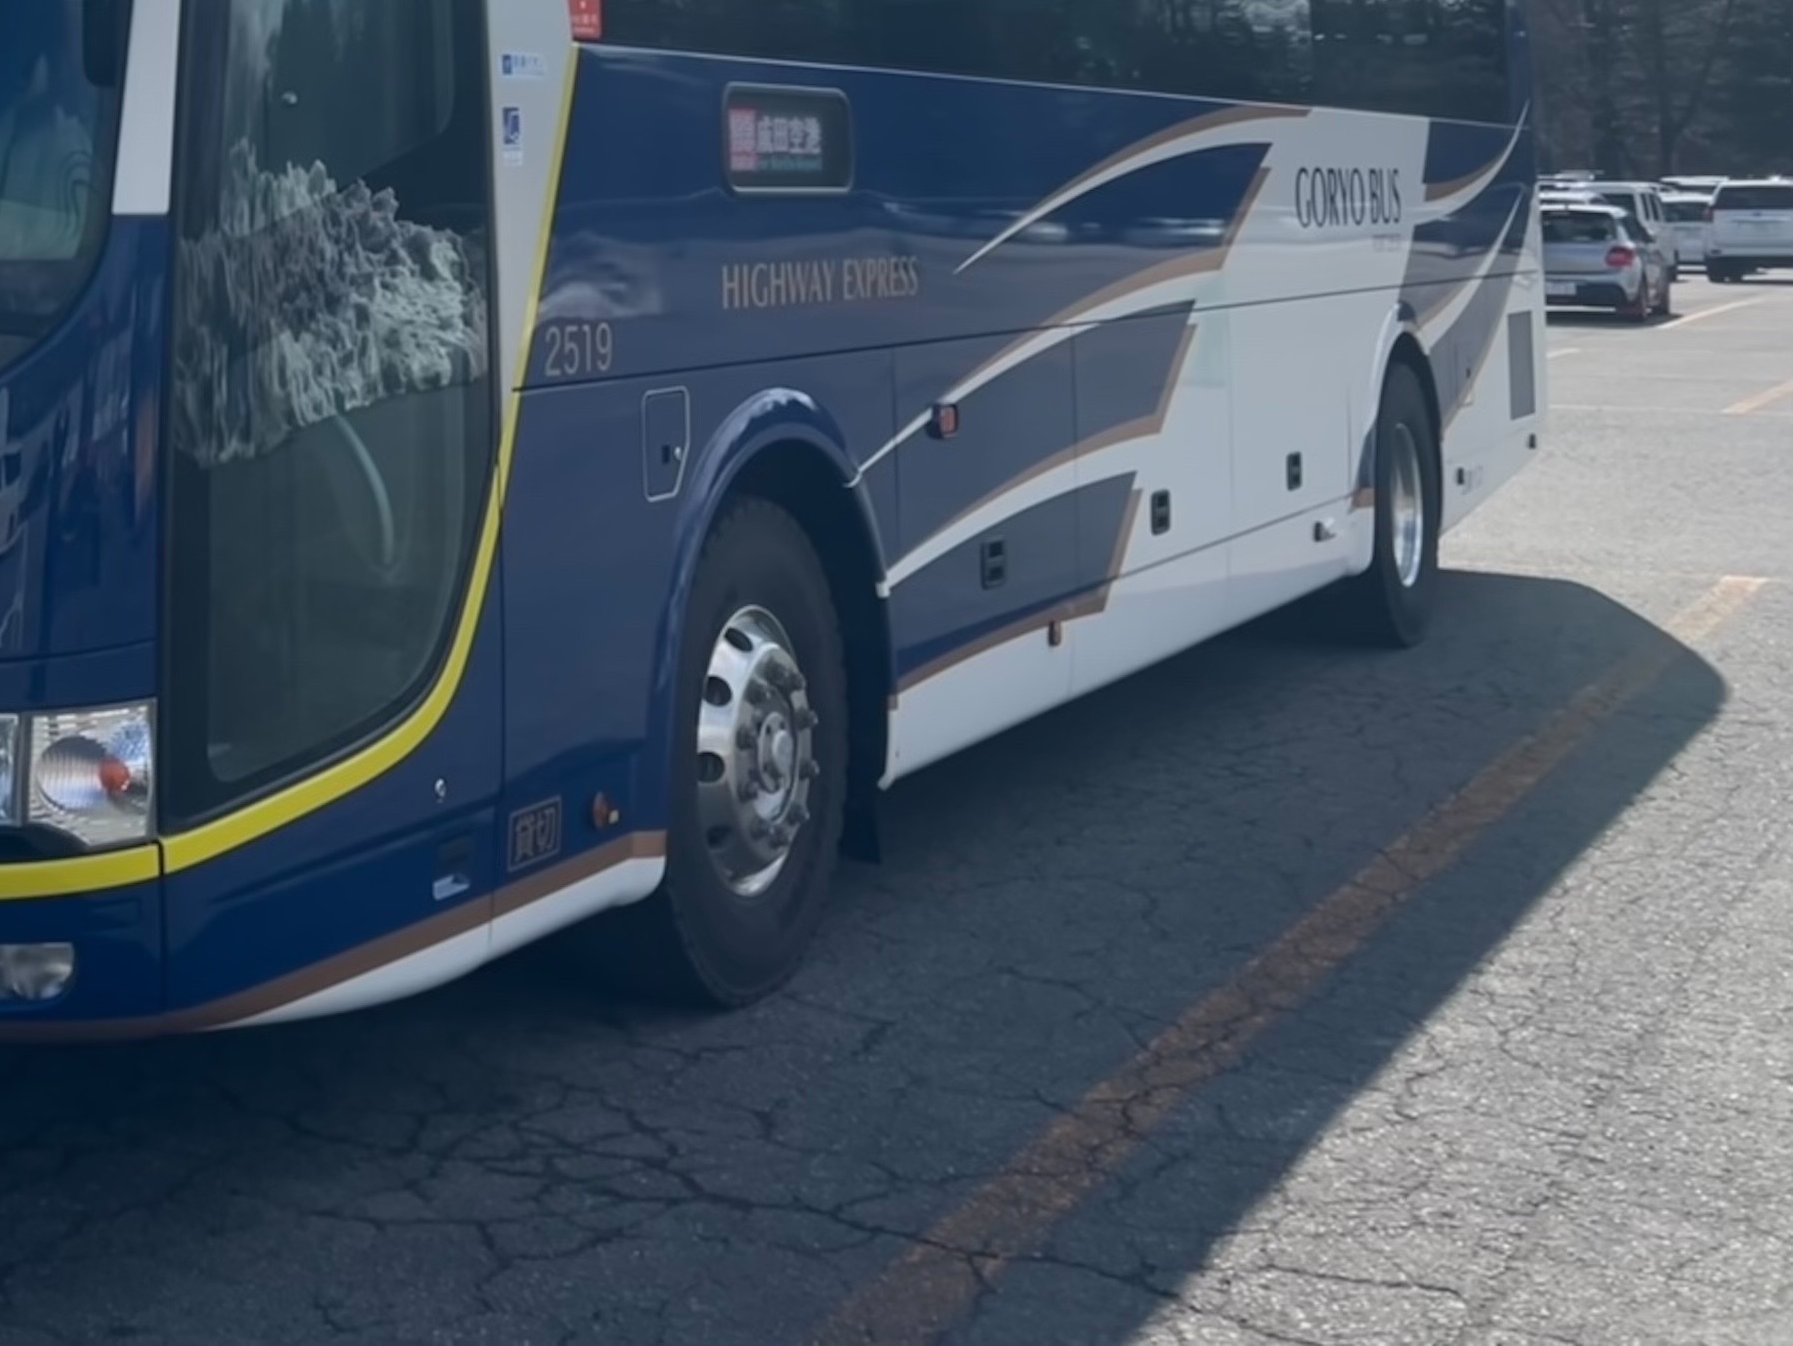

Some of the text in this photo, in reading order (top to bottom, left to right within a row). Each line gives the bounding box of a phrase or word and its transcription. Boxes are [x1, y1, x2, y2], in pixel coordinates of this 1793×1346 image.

[1295, 166, 1401, 229] GORYO BUS
[722, 256, 919, 310] HIGHWAY EXPRESS
[545, 322, 612, 377] 2519
